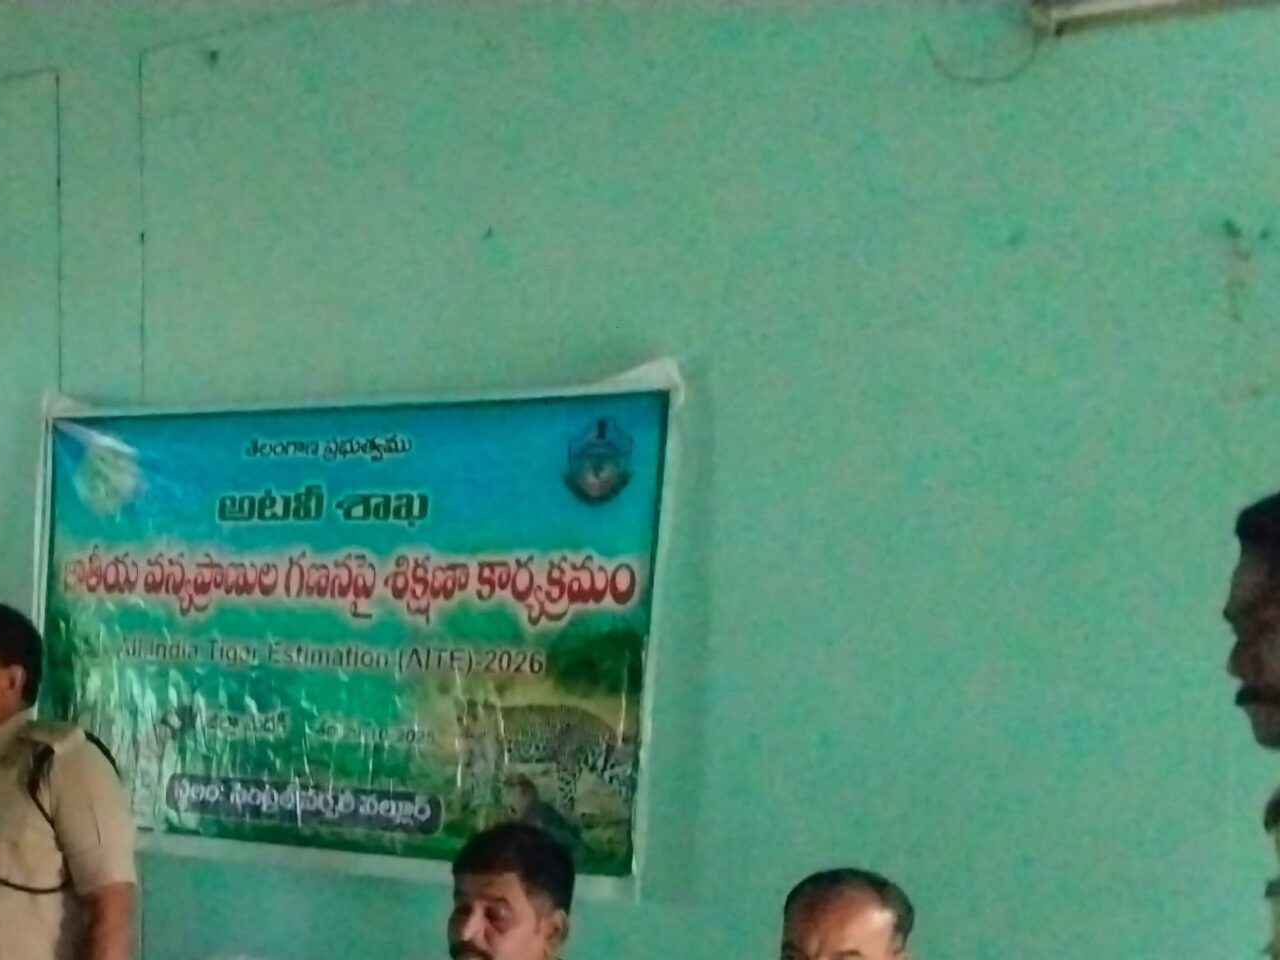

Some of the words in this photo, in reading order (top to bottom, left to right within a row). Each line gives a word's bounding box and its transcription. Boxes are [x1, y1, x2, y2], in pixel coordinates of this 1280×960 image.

[333, 492, 429, 528] శాఖ
[143, 552, 279, 617] వన్యప్రాణుల
[284, 550, 376, 619] గణనపై
[384, 554, 470, 625] శిక్షణా
[476, 554, 637, 626] కార్యక్రమం
[268, 641, 389, 670] Estimation
